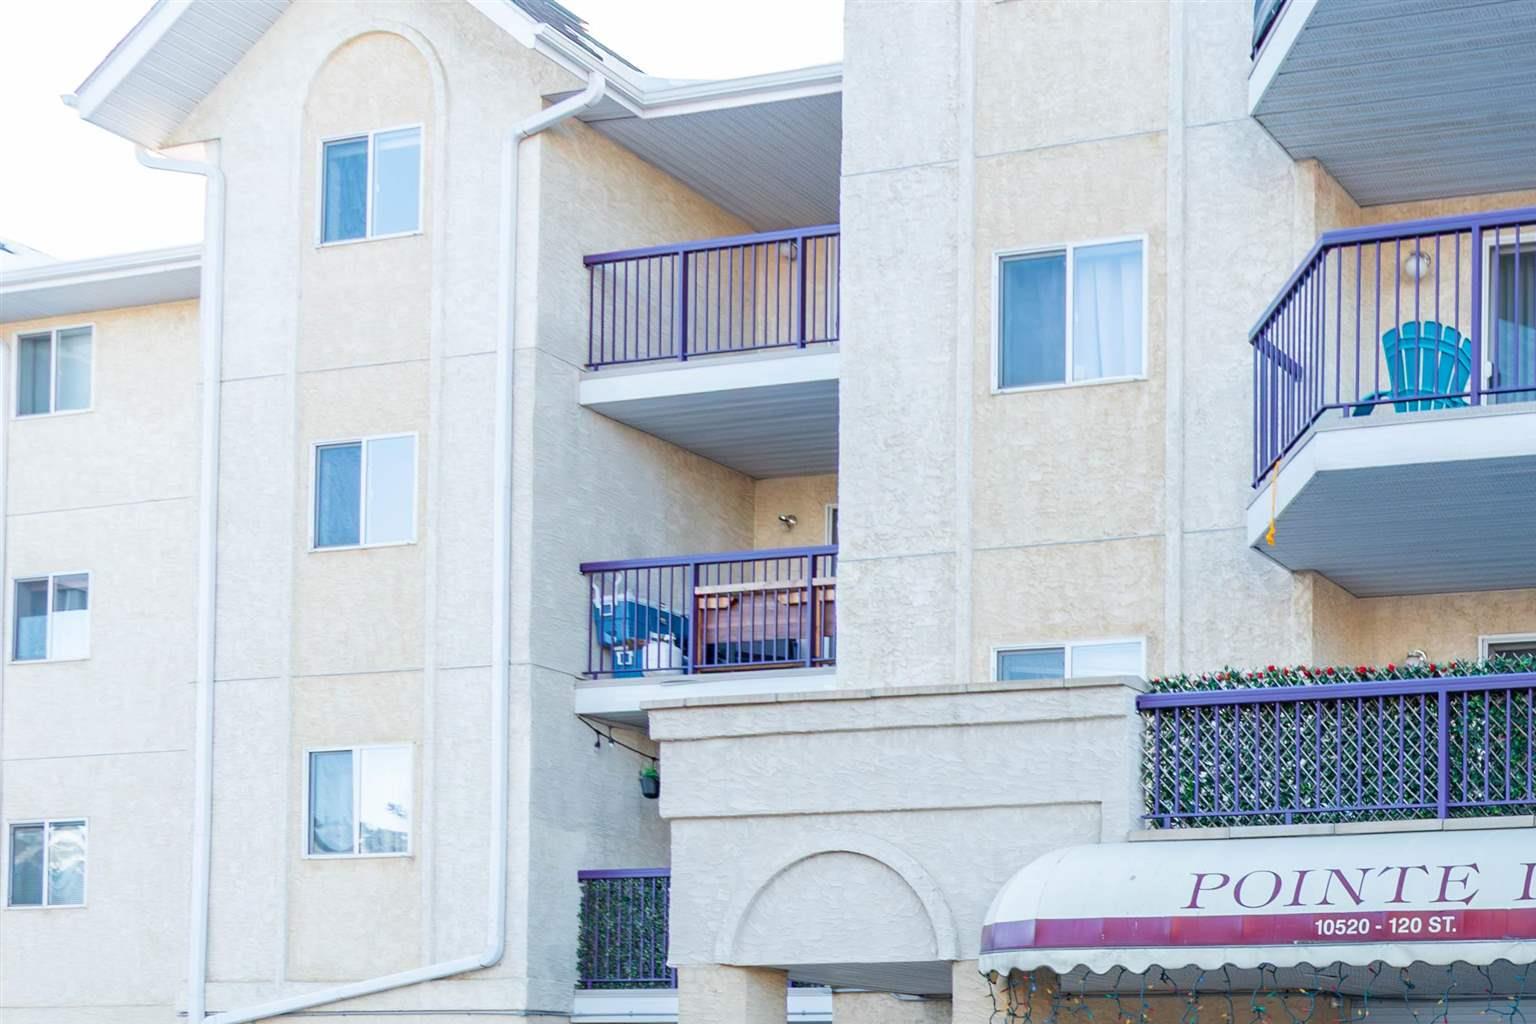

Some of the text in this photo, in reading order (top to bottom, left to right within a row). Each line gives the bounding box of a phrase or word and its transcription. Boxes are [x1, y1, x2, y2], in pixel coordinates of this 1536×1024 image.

[1180, 863, 1480, 909] POINTE
[1315, 919, 1370, 935] 10520
[1389, 917, 1422, 933] 120
[1428, 915, 1457, 933] ST.
